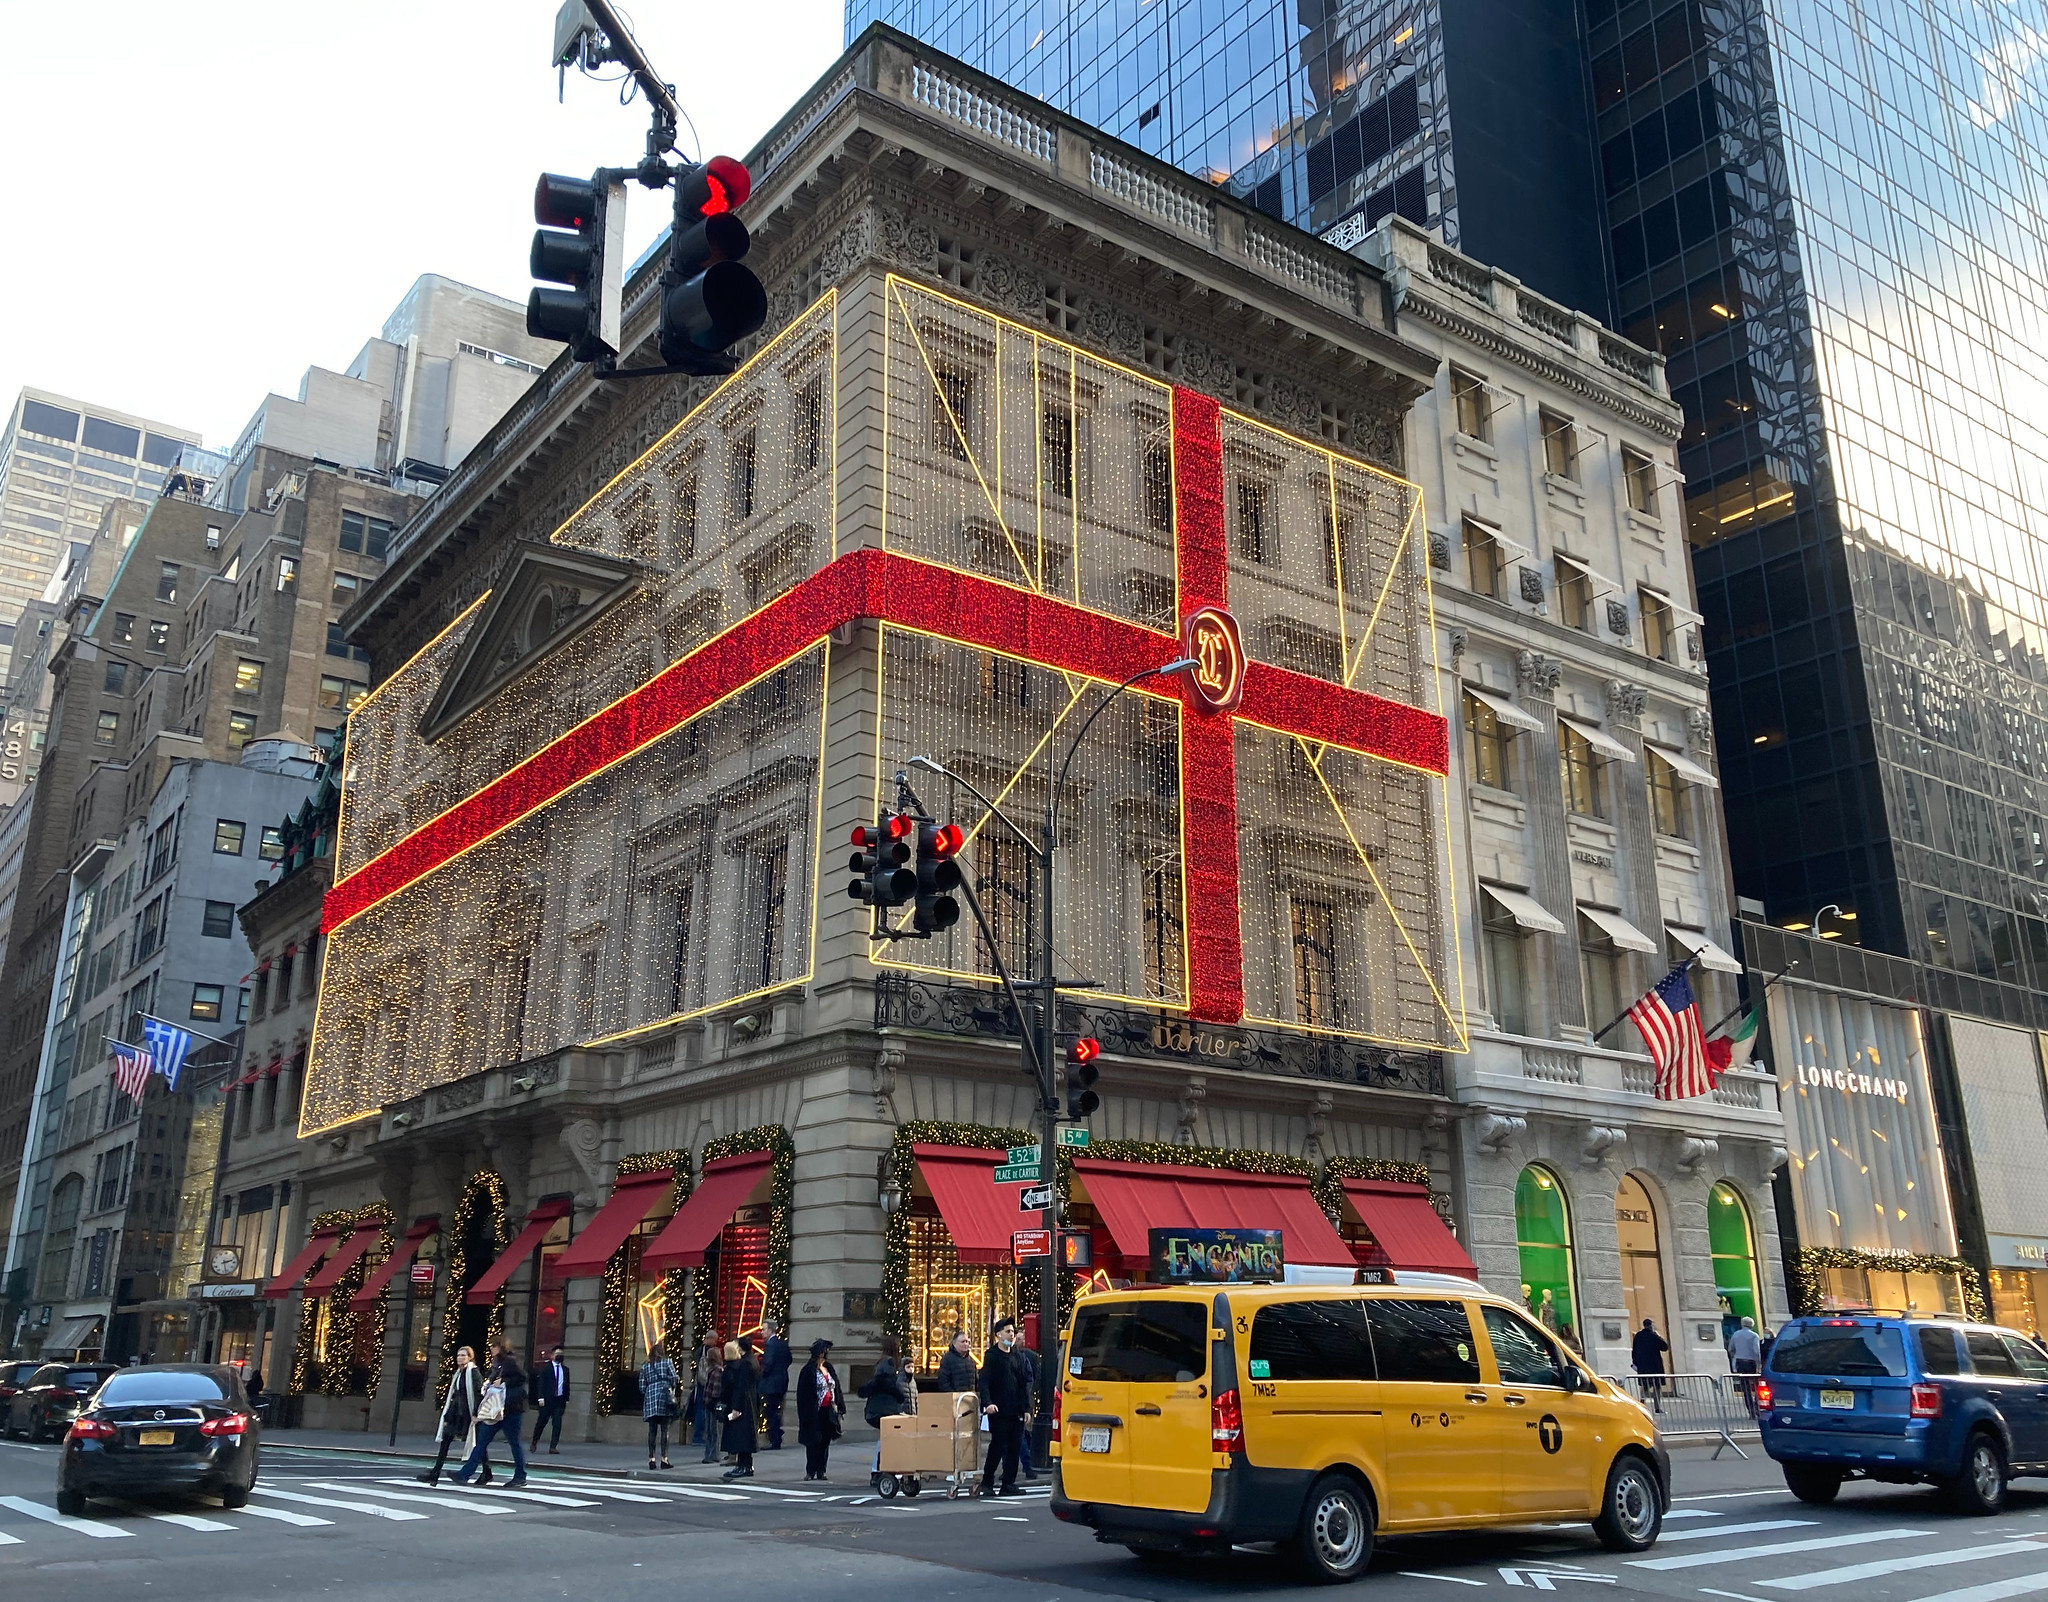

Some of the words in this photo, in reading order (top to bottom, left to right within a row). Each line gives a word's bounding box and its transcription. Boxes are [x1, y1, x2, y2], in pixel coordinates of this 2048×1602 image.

[1797, 1064, 1908, 1100] LONGCHAMP
[1067, 1131, 1074, 1144] 5
[1075, 1131, 1083, 1139] AV
[1008, 1151, 1014, 1164] E
[1016, 1149, 1029, 1163] 52
[995, 1169, 1011, 1181] PLACE
[1019, 1166, 1039, 1178] CARTIER
[1026, 1193, 1039, 1204] ONE
[1168, 1237, 1275, 1277] ENCANTO
[1363, 1271, 1382, 1283] 7M62
[212, 1285, 246, 1297] Cartier
[802, 1302, 821, 1314] Cartier
[1252, 1383, 1277, 1397] 7M62
[1543, 1422, 1556, 1450] T
